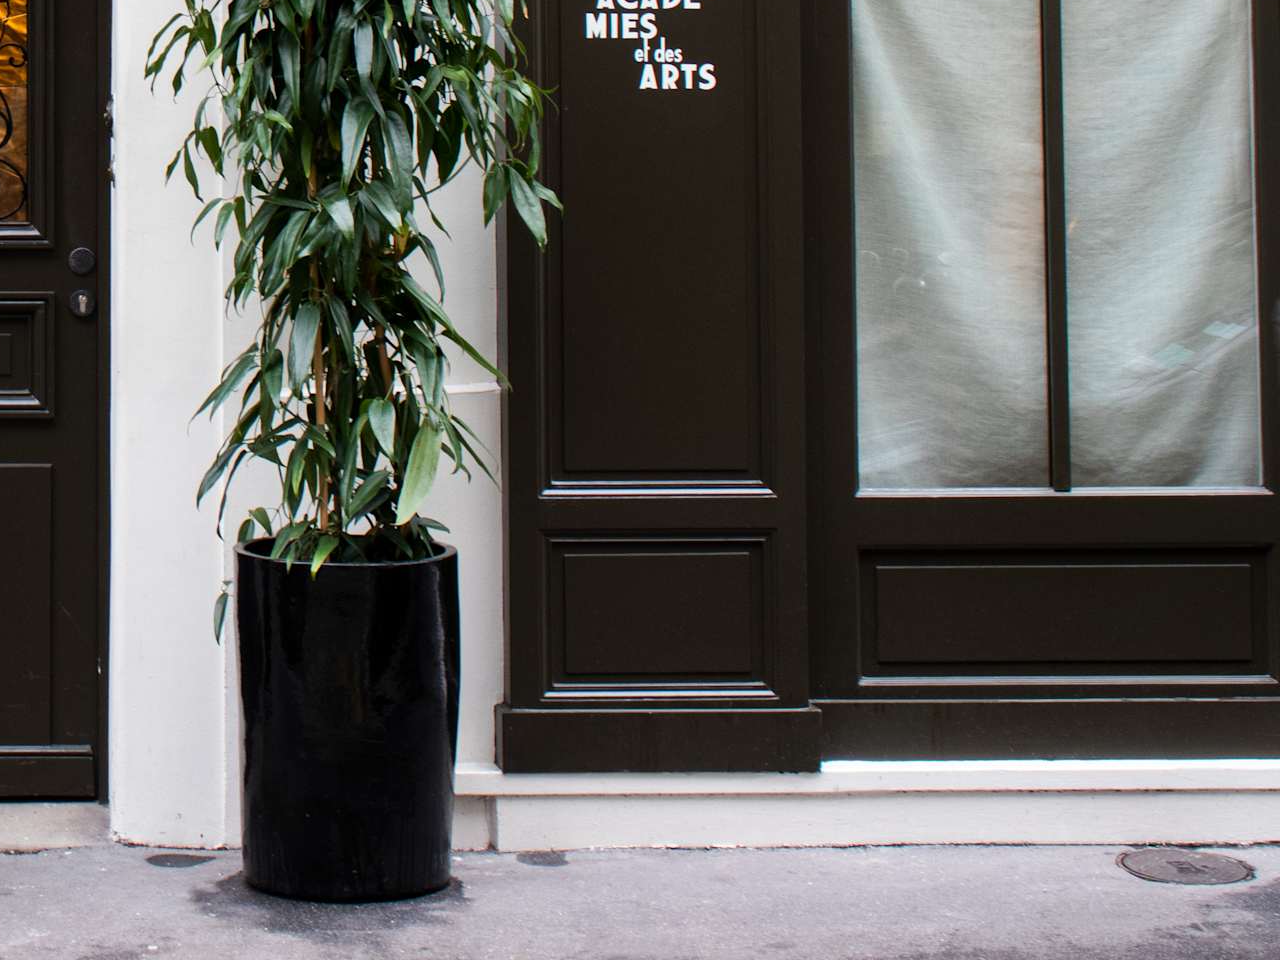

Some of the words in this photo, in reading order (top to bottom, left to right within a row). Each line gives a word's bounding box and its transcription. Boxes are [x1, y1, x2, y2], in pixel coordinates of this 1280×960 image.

[585, 13, 658, 40] MIES
[634, 38, 651, 63] et
[654, 37, 683, 63] des
[639, 63, 717, 90] ARTS
